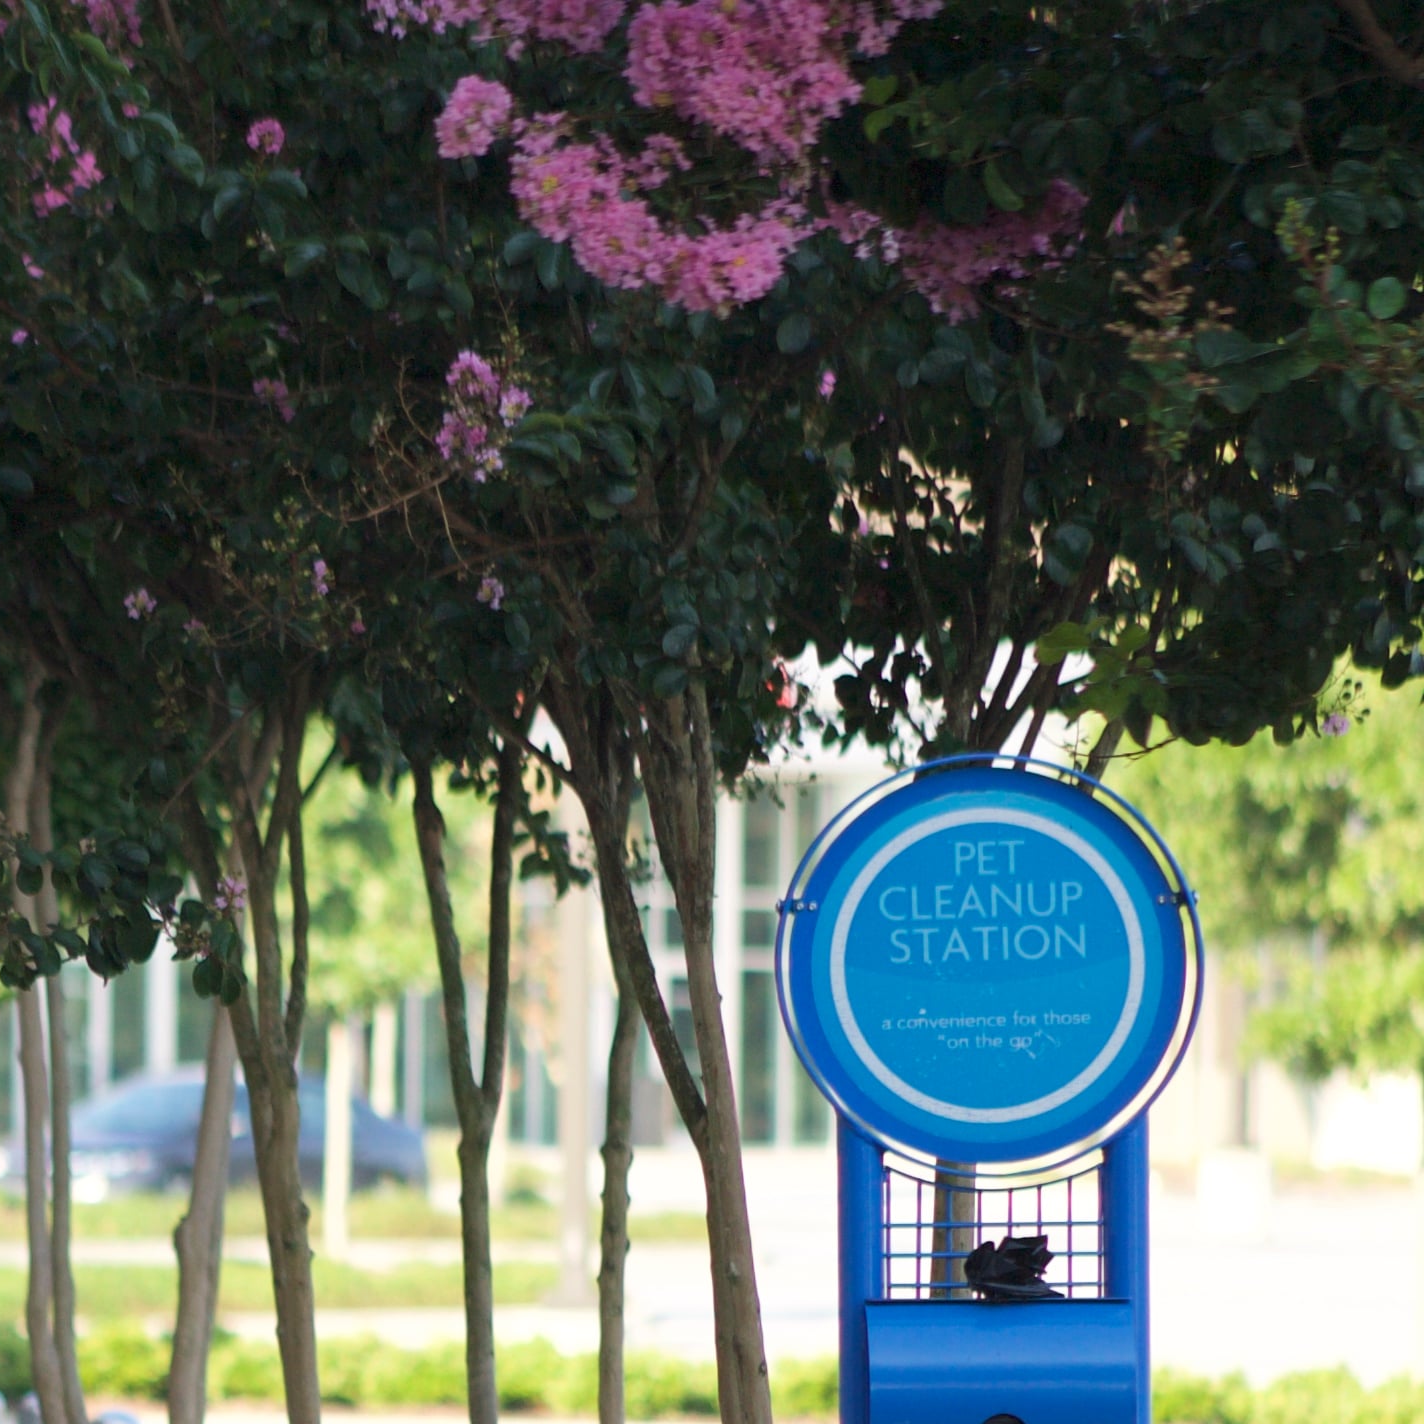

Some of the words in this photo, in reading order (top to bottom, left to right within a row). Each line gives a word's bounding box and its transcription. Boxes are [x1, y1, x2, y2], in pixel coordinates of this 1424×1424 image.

[955, 840, 1025, 876] PET
[879, 882, 1083, 921] CLEANUP
[890, 924, 1087, 964] STATION
[881, 1018, 892, 1031] a
[896, 1012, 1007, 1030] convenience
[1013, 1010, 1036, 1026] for
[1043, 1010, 1092, 1026] those
[975, 1033, 1003, 1049] the
